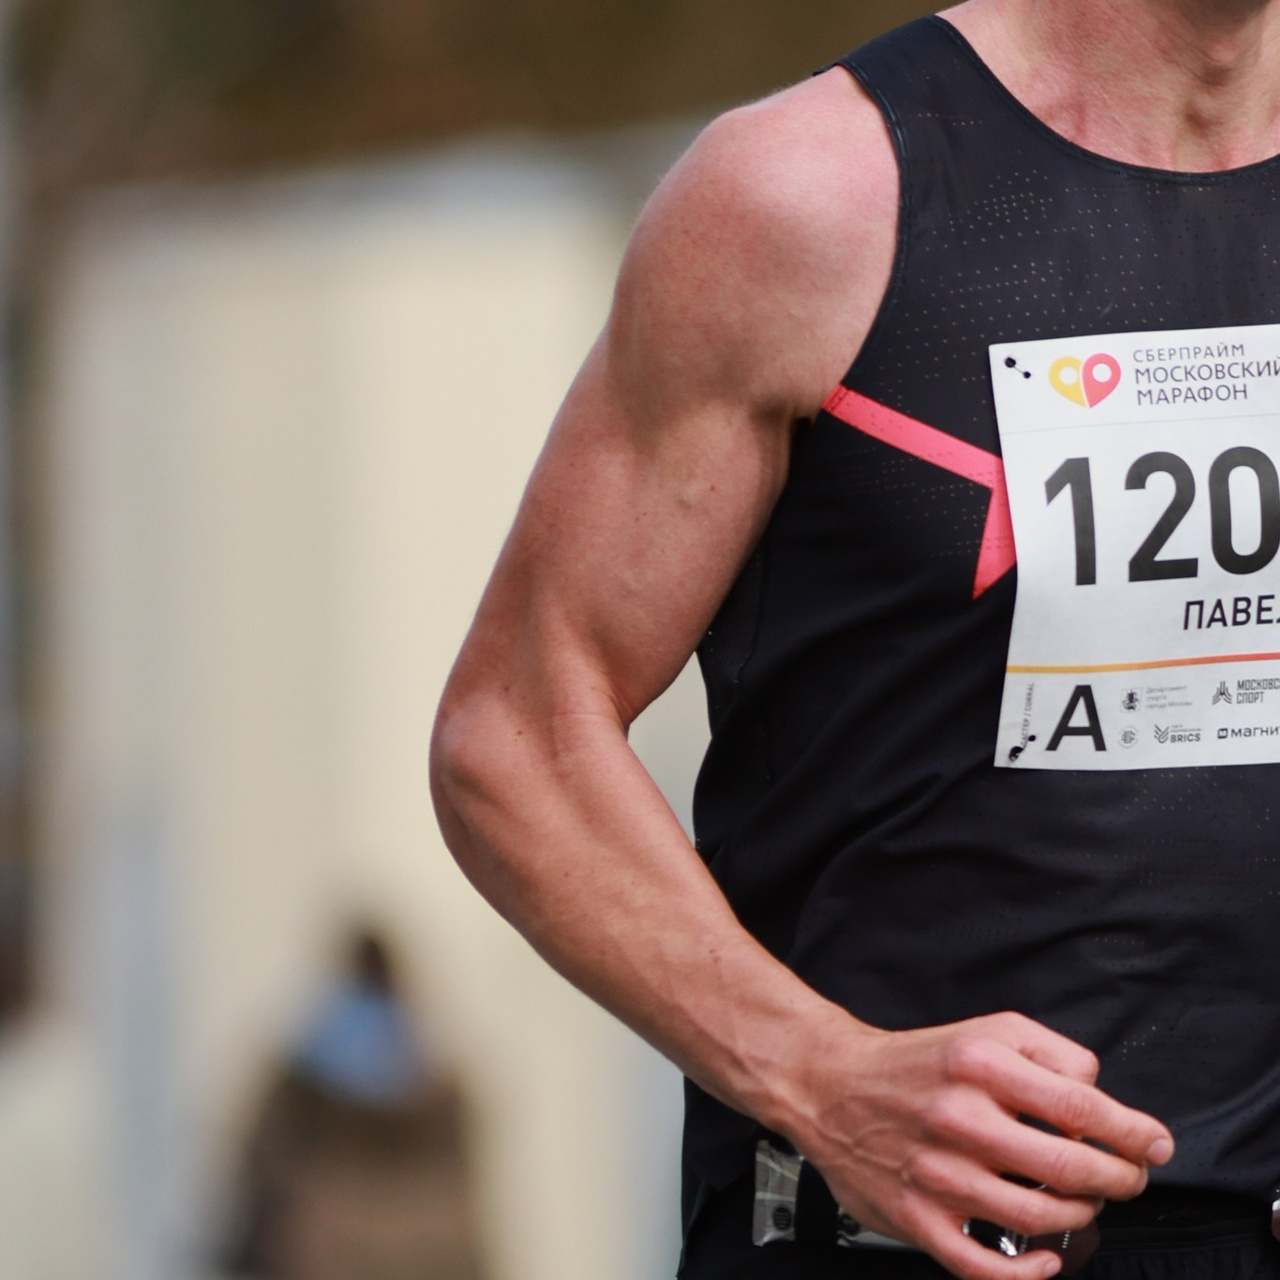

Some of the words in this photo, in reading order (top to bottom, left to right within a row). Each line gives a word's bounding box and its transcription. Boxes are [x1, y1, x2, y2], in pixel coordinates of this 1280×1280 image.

[1133, 343, 1246, 363] СБЕРПРАЙМ
[1138, 383, 1248, 406] МАРАФОН
[1236, 691, 1265, 705] СПОРТ
[1170, 733, 1201, 743] BRICS
